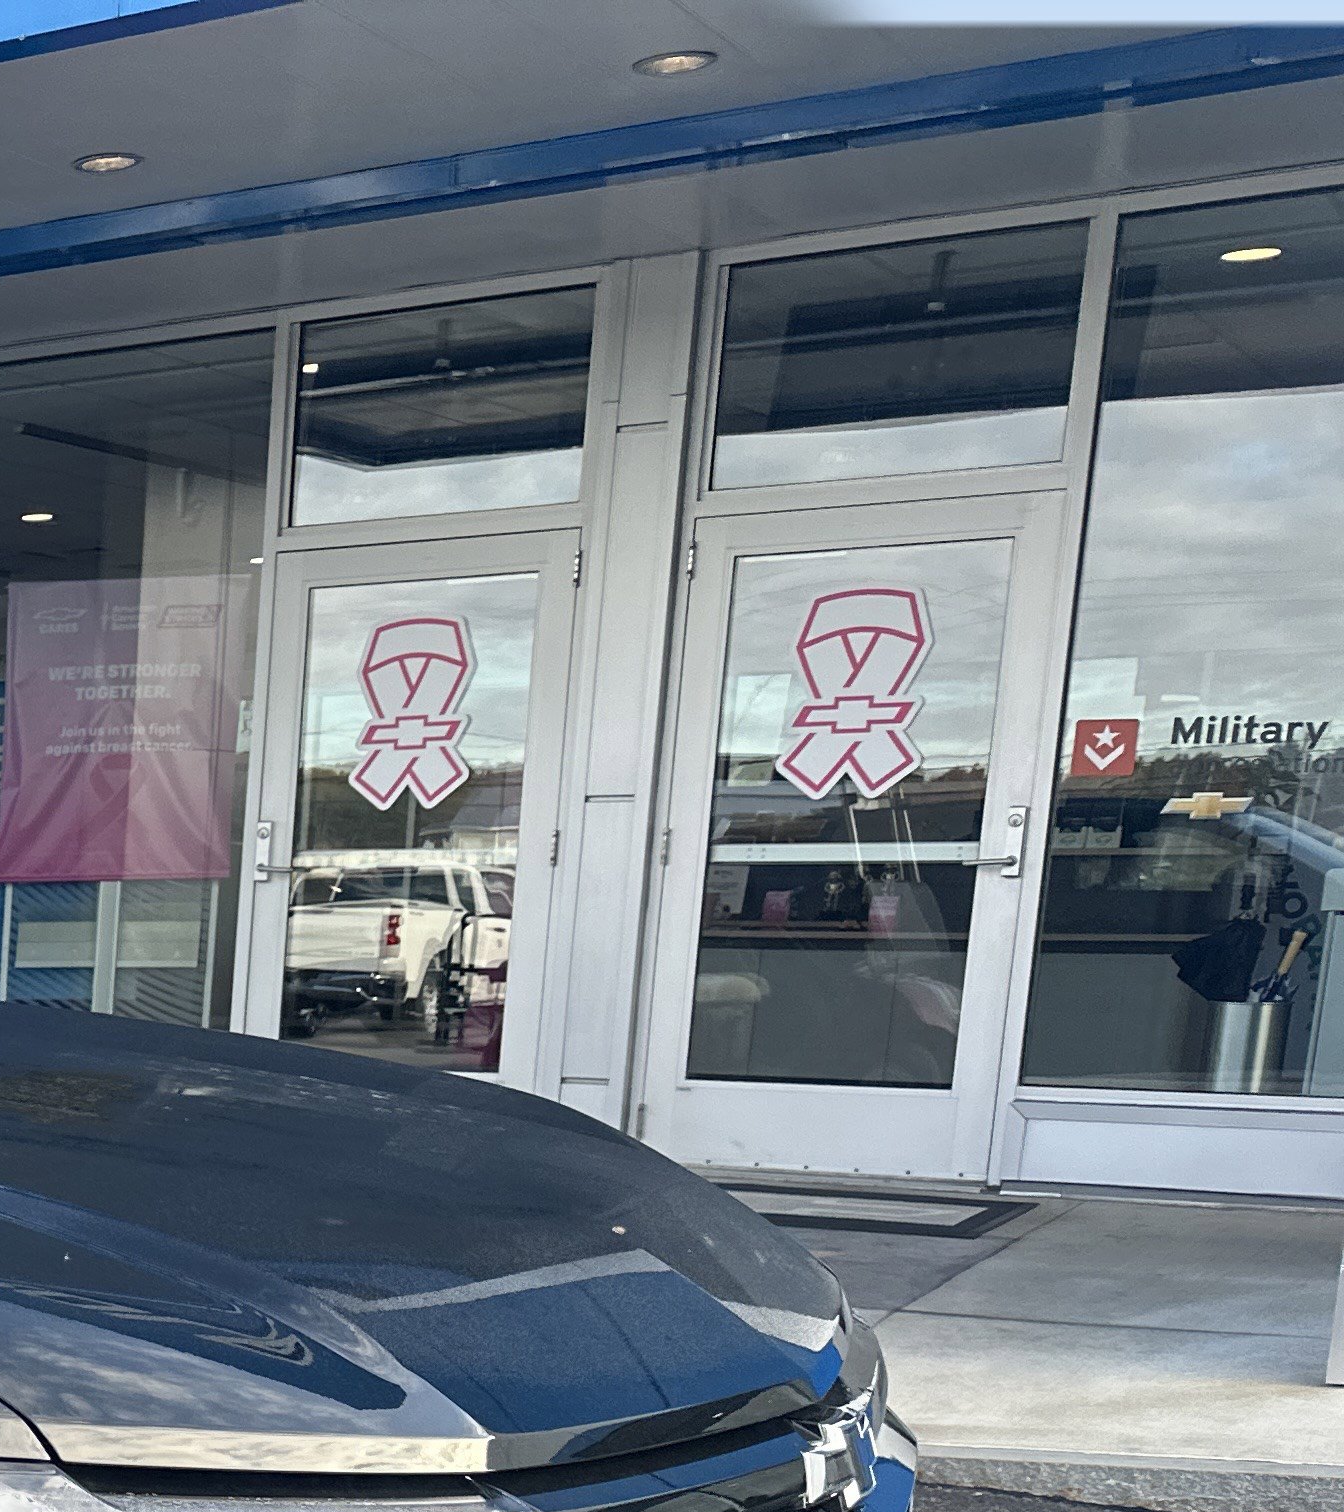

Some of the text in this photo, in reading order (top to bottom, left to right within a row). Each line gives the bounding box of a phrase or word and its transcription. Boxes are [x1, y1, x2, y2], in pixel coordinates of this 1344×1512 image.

[47, 663, 201, 681] WE'RE STRONGER
[60, 725, 86, 738] Join
[89, 726, 105, 736] us
[148, 722, 181, 739] fight
[1171, 714, 1329, 750] Military
[45, 742, 96, 757] against
